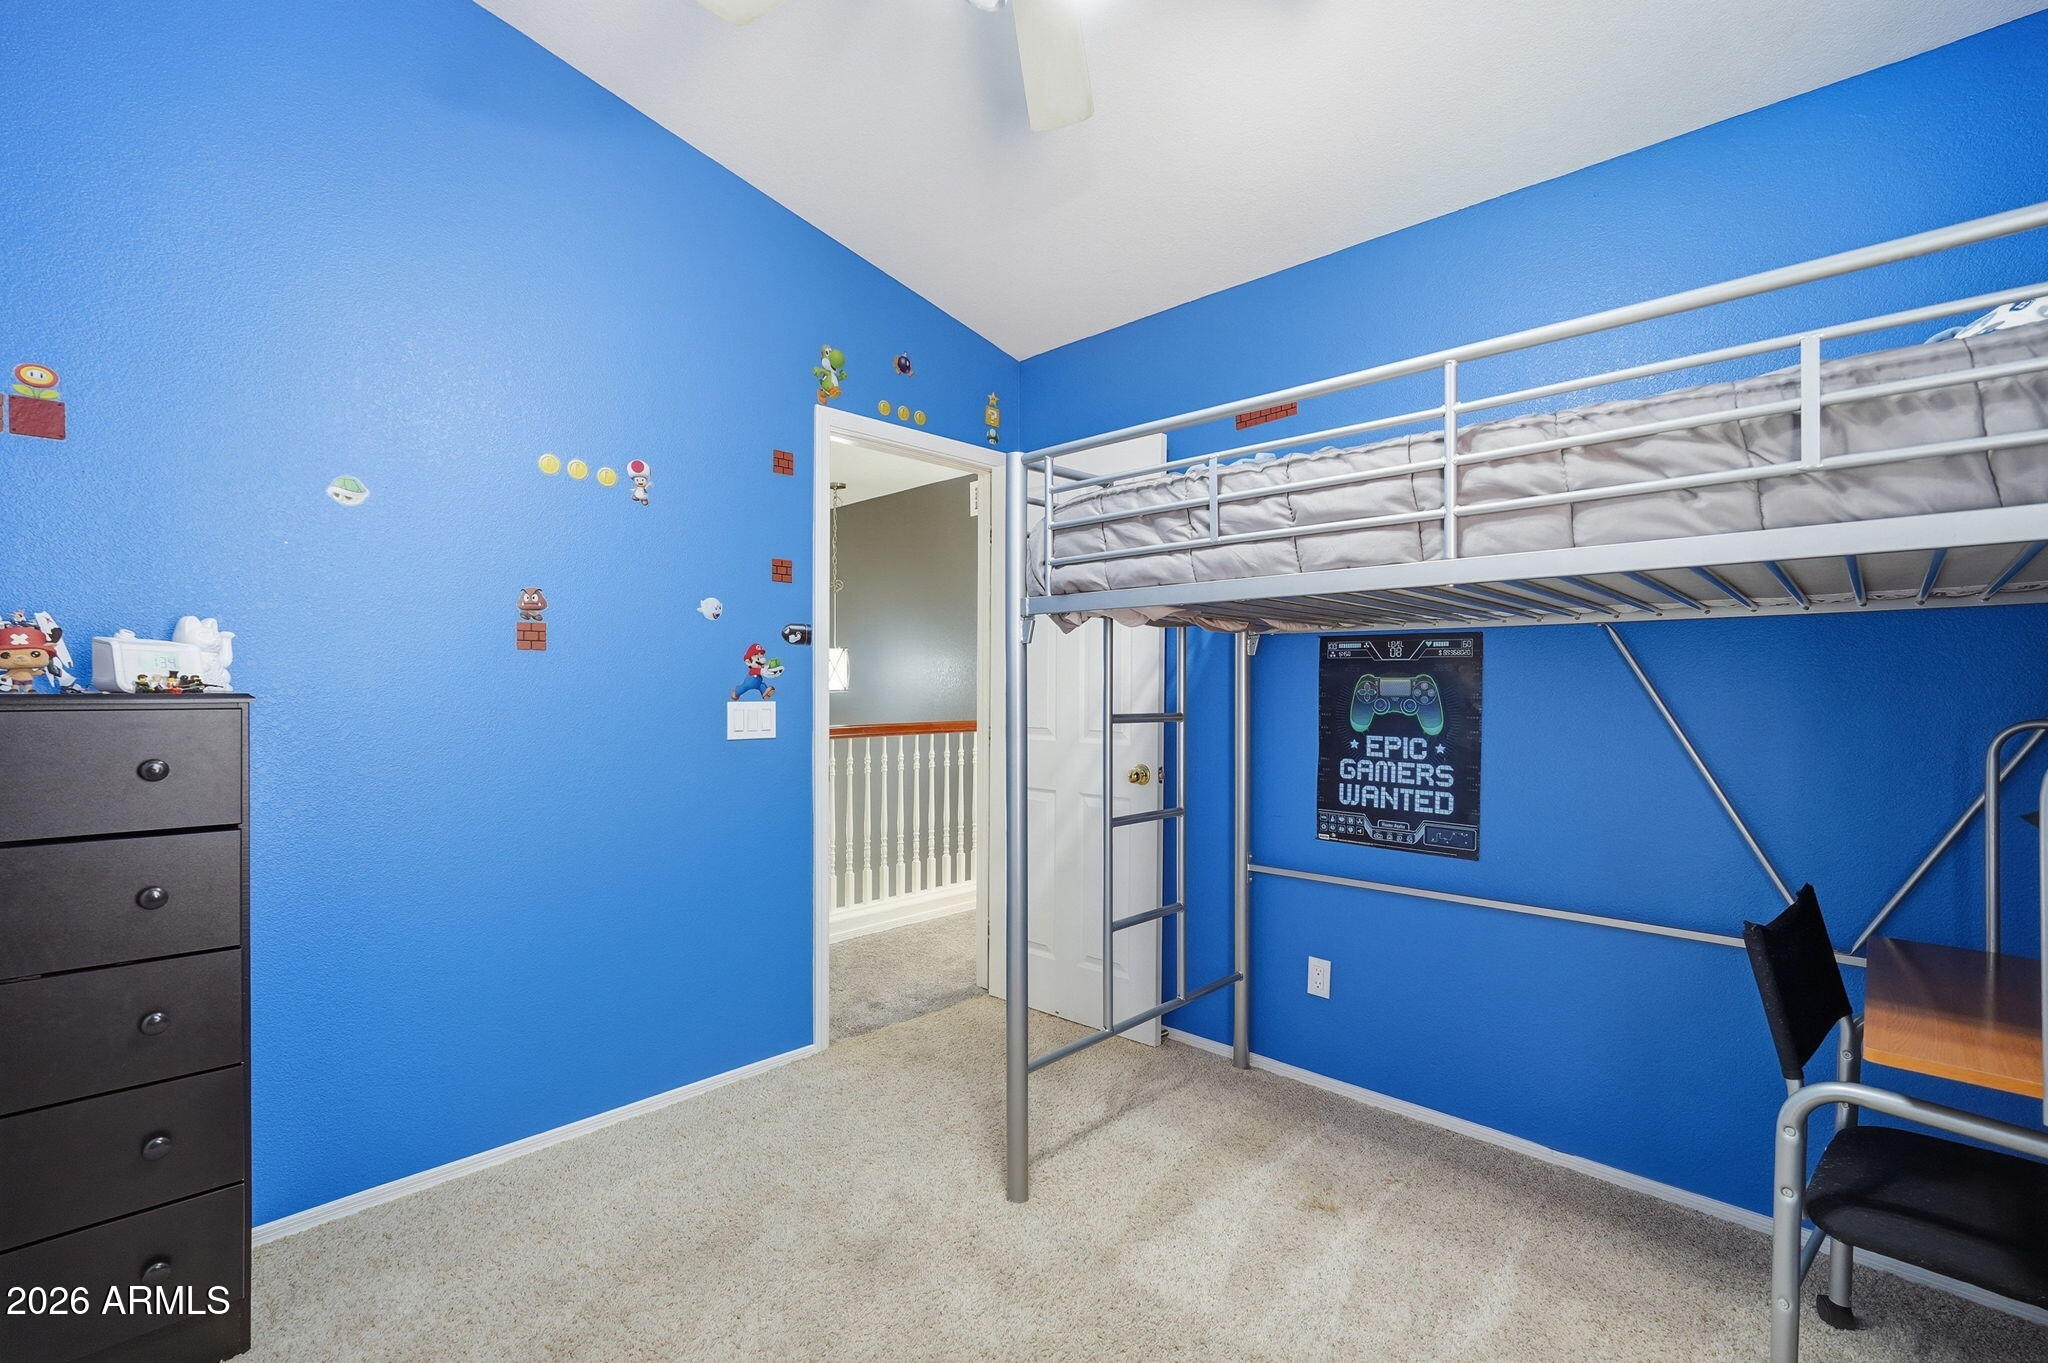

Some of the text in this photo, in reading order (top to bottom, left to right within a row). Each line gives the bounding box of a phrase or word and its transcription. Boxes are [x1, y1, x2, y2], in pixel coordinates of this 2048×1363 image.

[1389, 647, 1403, 658] 08
[1366, 735, 1428, 760] EPIC
[1339, 758, 1455, 787] GAMERS
[1338, 783, 1455, 815] WANTED
